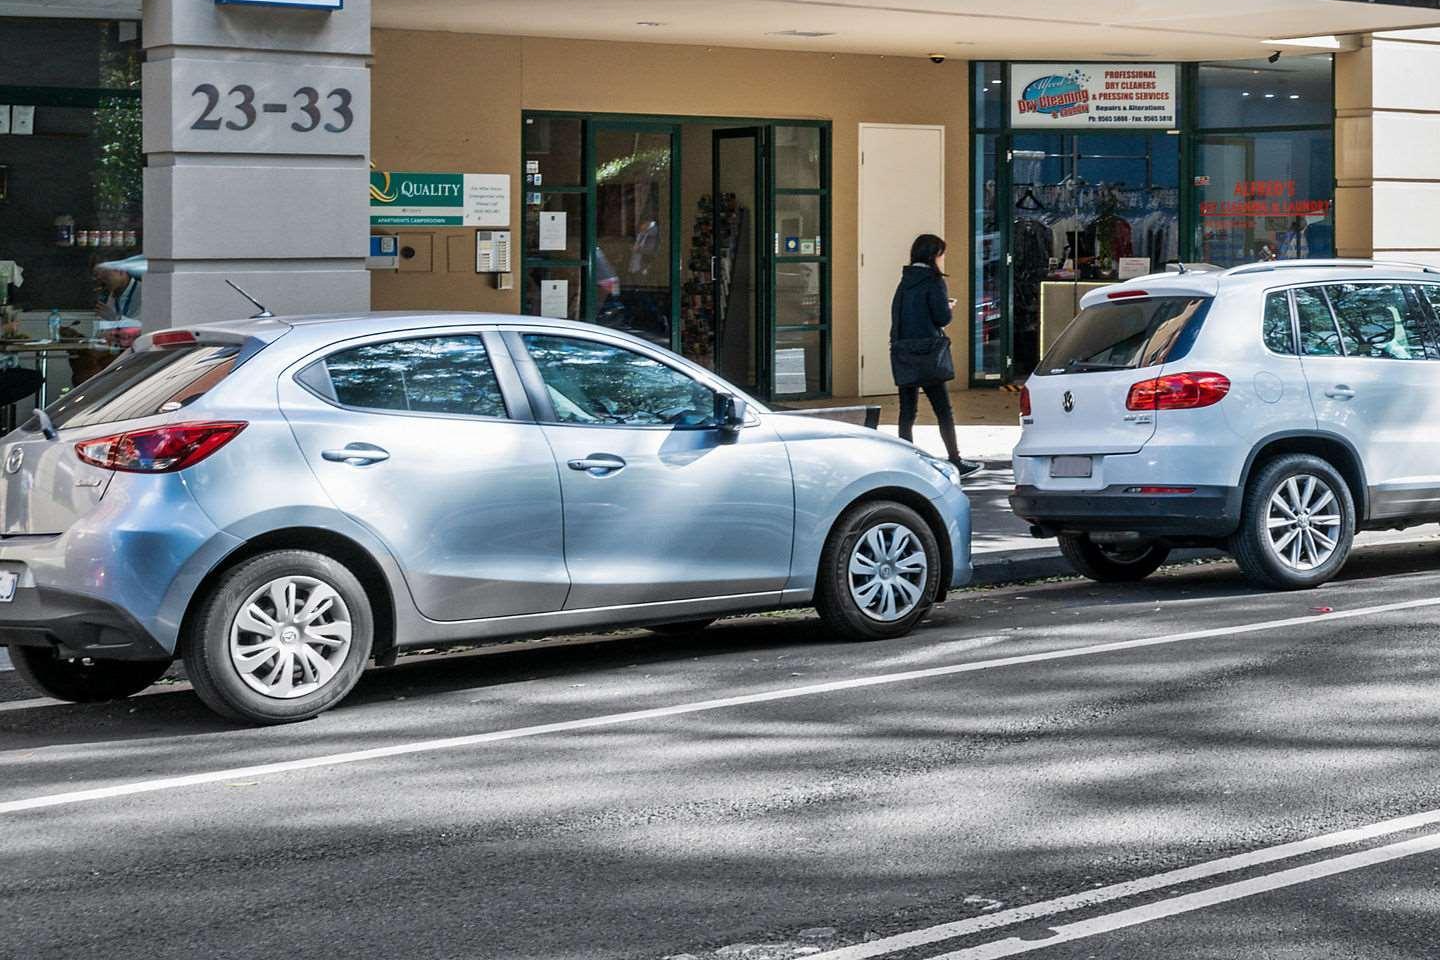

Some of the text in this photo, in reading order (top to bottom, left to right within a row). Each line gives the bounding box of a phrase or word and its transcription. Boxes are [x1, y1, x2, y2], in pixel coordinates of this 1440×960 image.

[1104, 70, 1156, 79] PROFESSIONAL
[1105, 81, 1156, 90] DRY CLEANERS
[1017, 90, 1089, 113] Dry Cleaning
[1098, 92, 1135, 101] PRESSING
[1136, 92, 1170, 101] SERVICES
[190, 83, 354, 133] 23-33
[1095, 105, 1122, 113] Repairs
[401, 181, 460, 198] QUALITY
[1234, 180, 1296, 196] ALFRED'S
